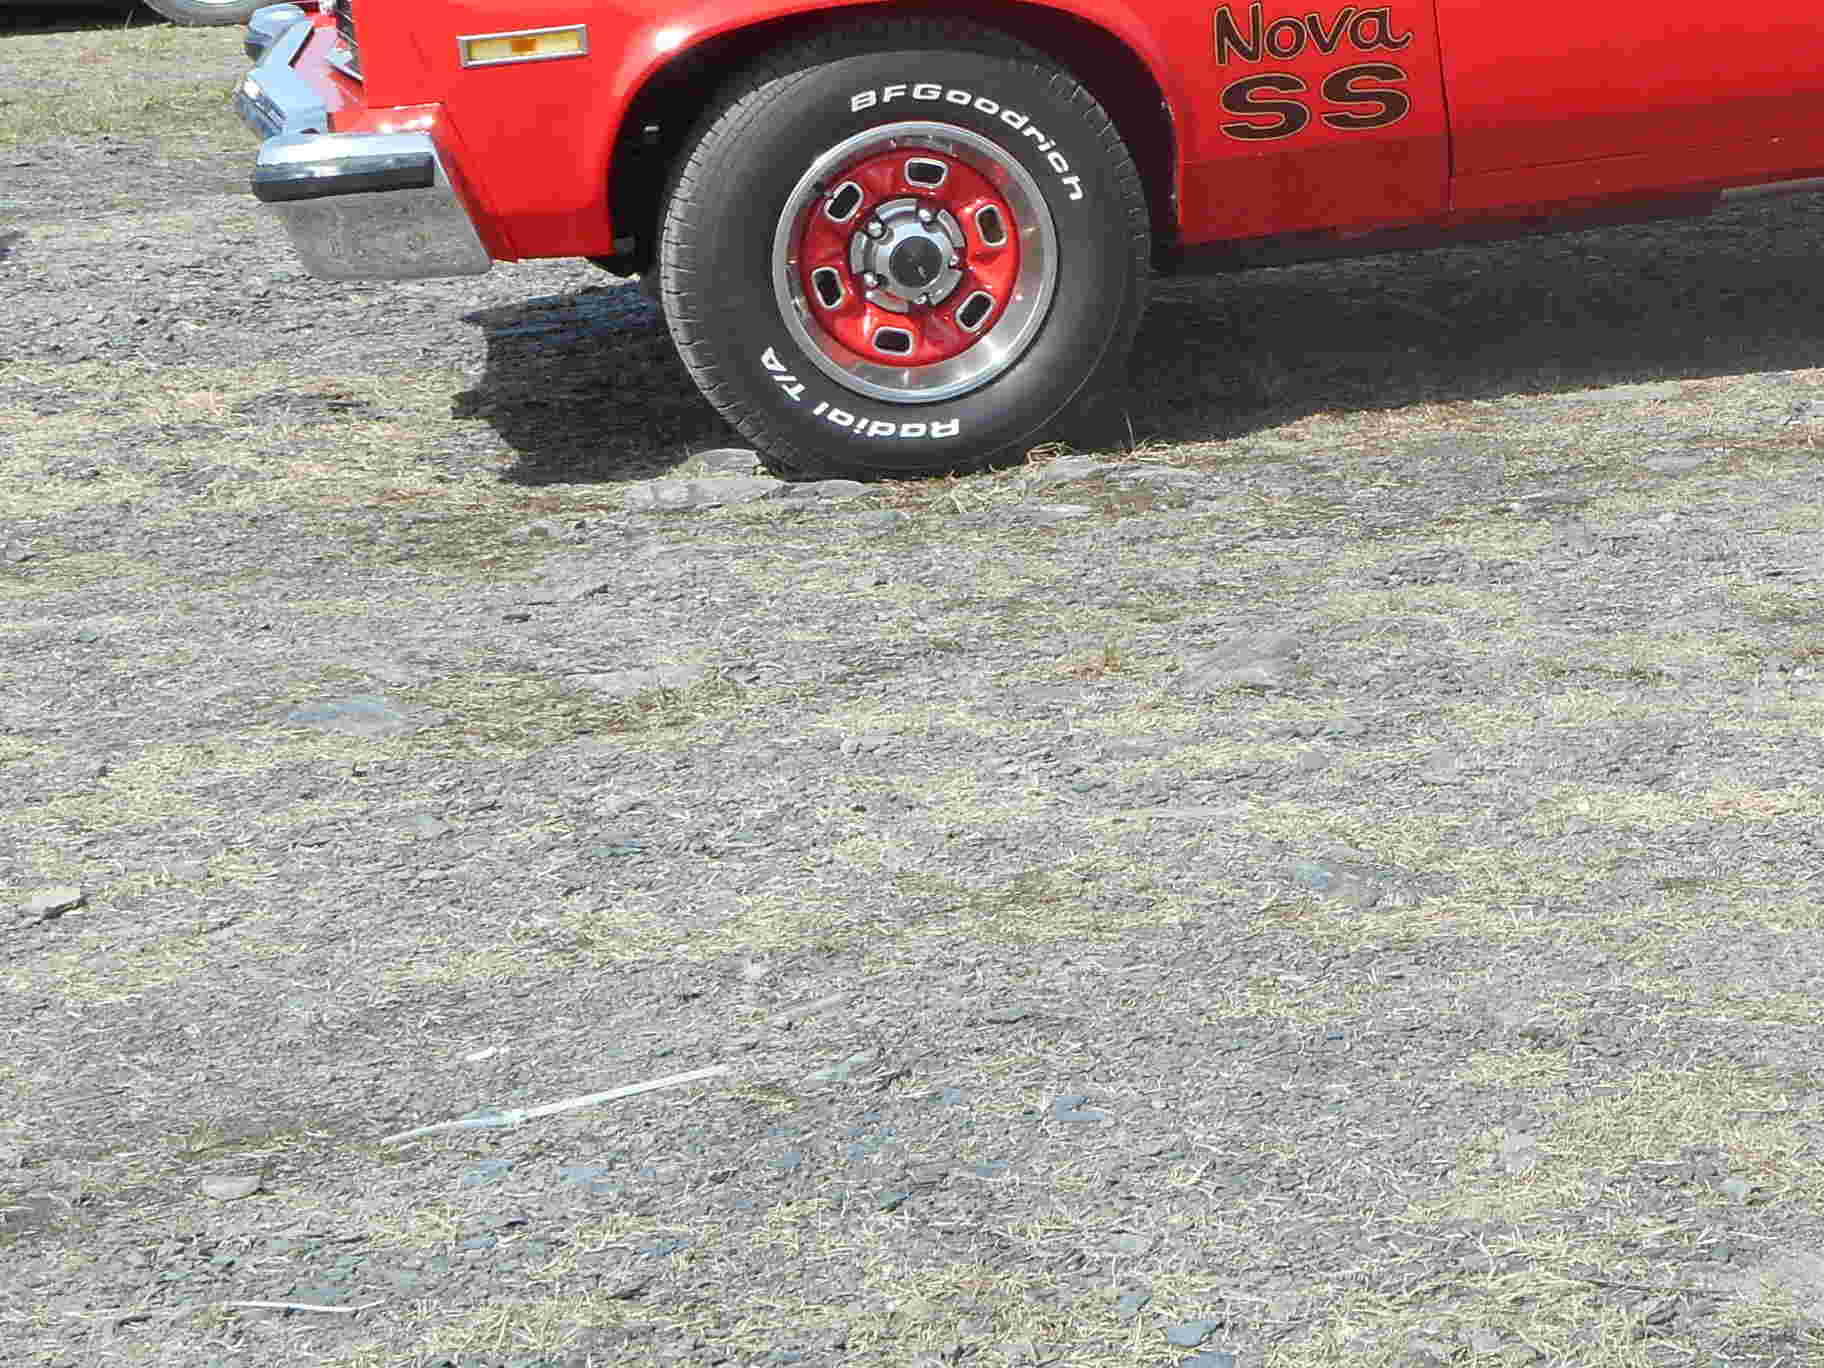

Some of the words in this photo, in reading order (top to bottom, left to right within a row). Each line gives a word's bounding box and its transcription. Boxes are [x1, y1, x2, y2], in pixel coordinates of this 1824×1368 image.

[1213, 0, 1415, 67] Nova
[1218, 62, 1411, 142] SS
[849, 82, 1085, 201] BFGoodrich
[760, 345, 807, 402] T/A
[812, 400, 962, 440] Radial
